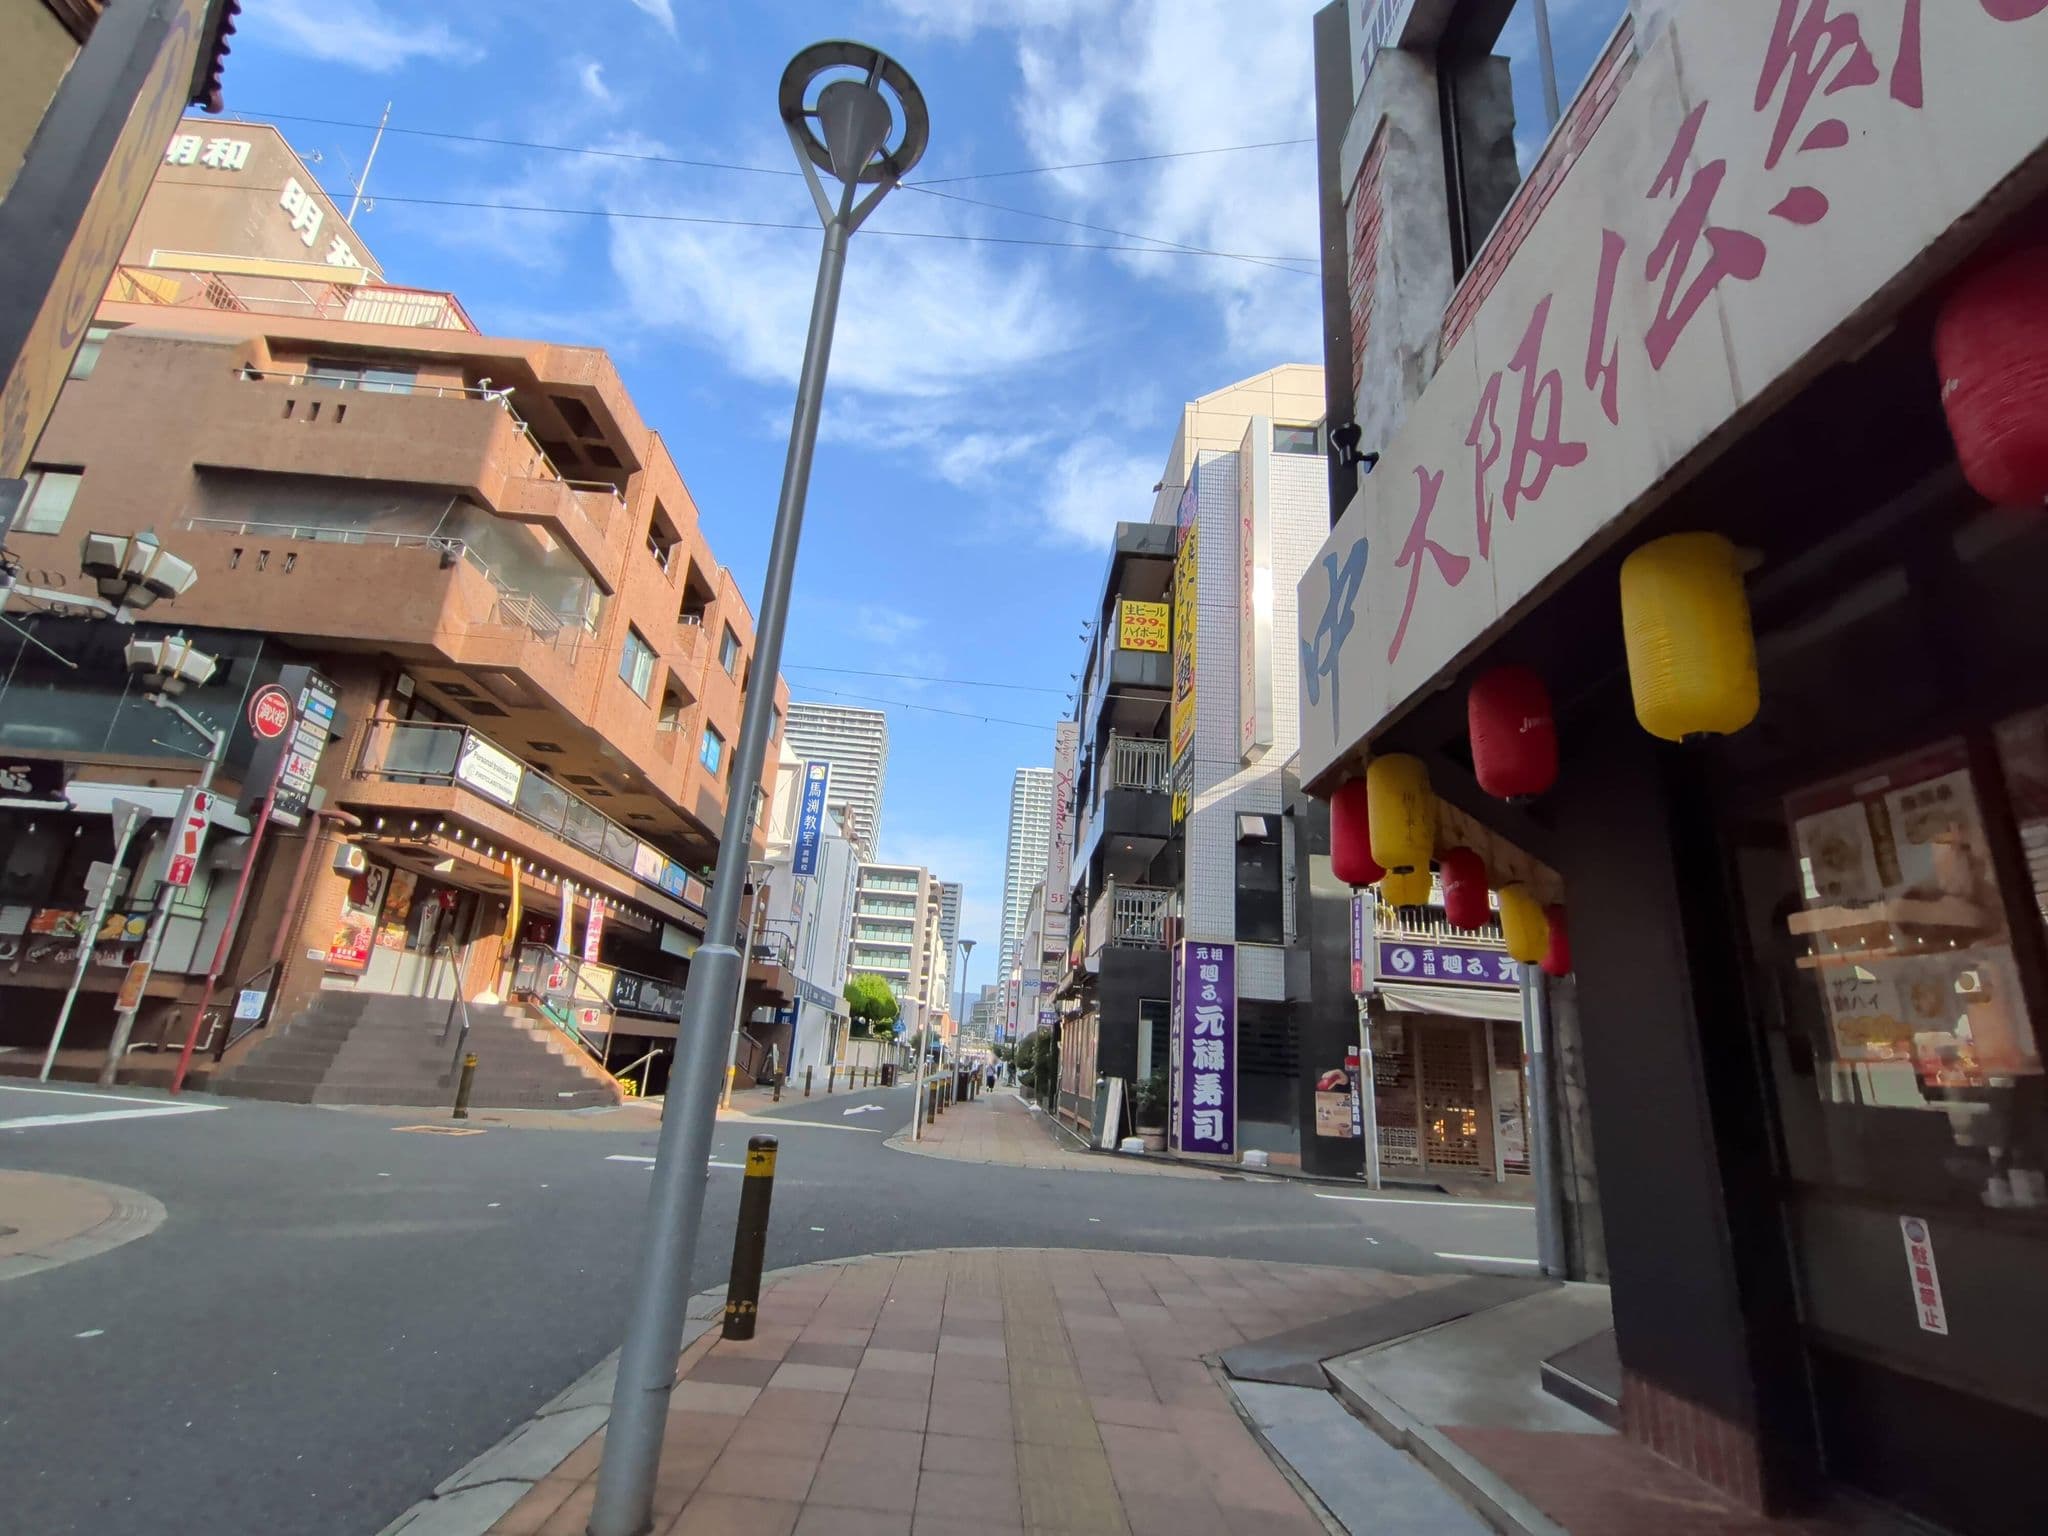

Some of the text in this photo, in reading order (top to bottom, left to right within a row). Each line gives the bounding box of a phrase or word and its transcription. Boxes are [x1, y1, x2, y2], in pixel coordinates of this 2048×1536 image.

[1125, 604, 1166, 617] 生ビール
[1124, 627, 1165, 640] ハイボール
[258, 703, 286, 728] 消火栓
[1197, 947, 1223, 961] 元祖
[1423, 949, 1436, 976] 元祖
[1442, 955, 1484, 975] 廻る
[1200, 964, 1219, 1001] 廻る
[1192, 1005, 1225, 1142] 元禄寿司
